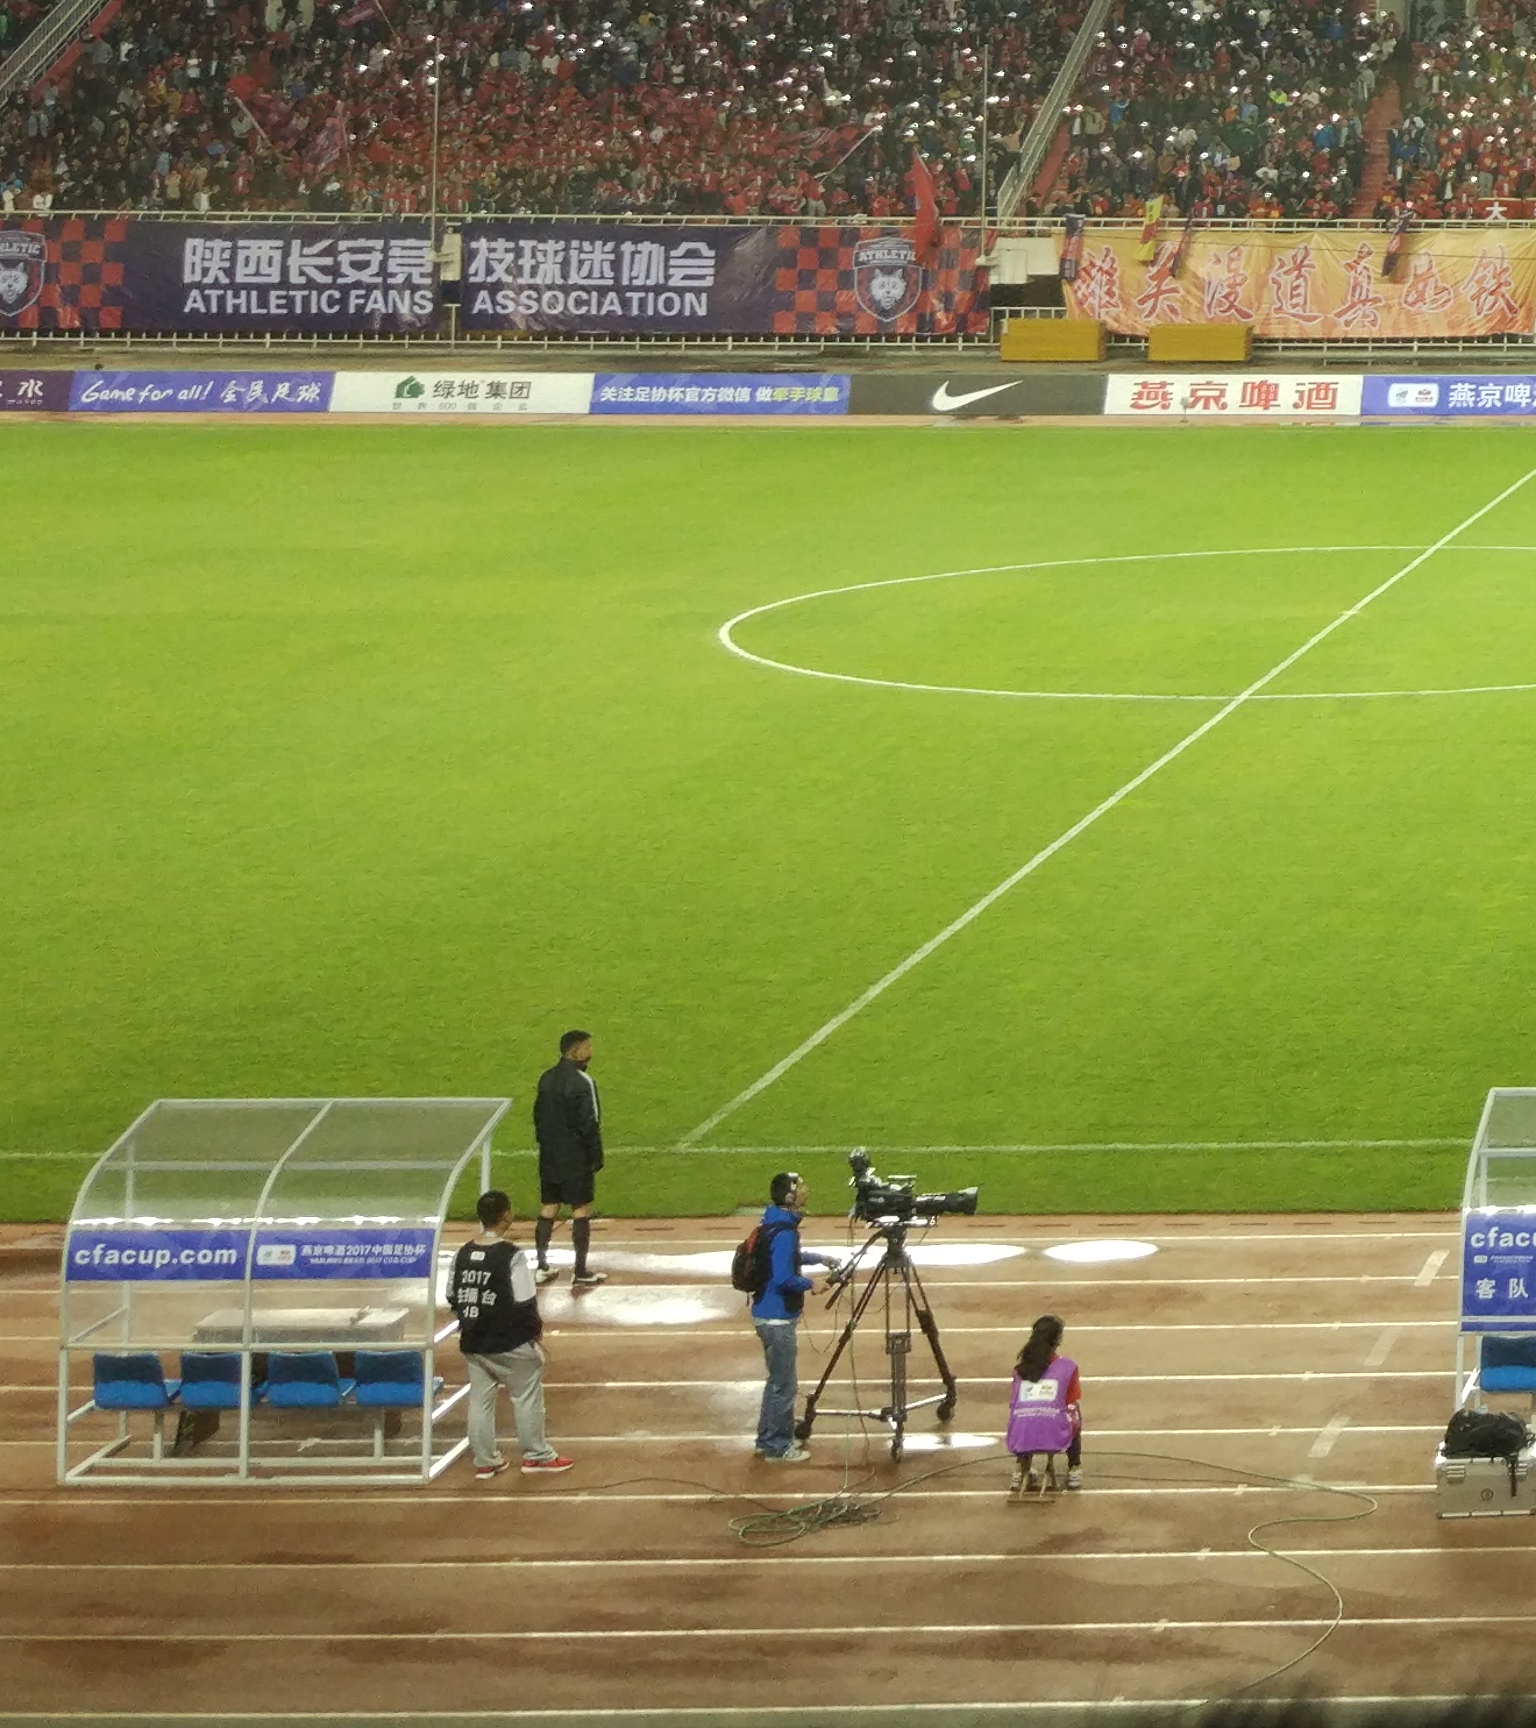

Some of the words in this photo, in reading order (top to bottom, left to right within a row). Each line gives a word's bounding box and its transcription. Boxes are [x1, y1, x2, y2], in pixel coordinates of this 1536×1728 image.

[184, 289, 341, 315] ATHLETIC
[348, 290, 434, 315] FANS
[471, 290, 709, 317] ASSOCIATION
[81, 380, 134, 403] Game
[137, 382, 173, 405] for
[178, 379, 215, 403] all!
[220, 379, 322, 405] 全民足球
[1130, 380, 1340, 412] 燕京啤酒
[74, 1242, 238, 1268] cfacup.com
[1475, 1278, 1529, 1300] 客队
